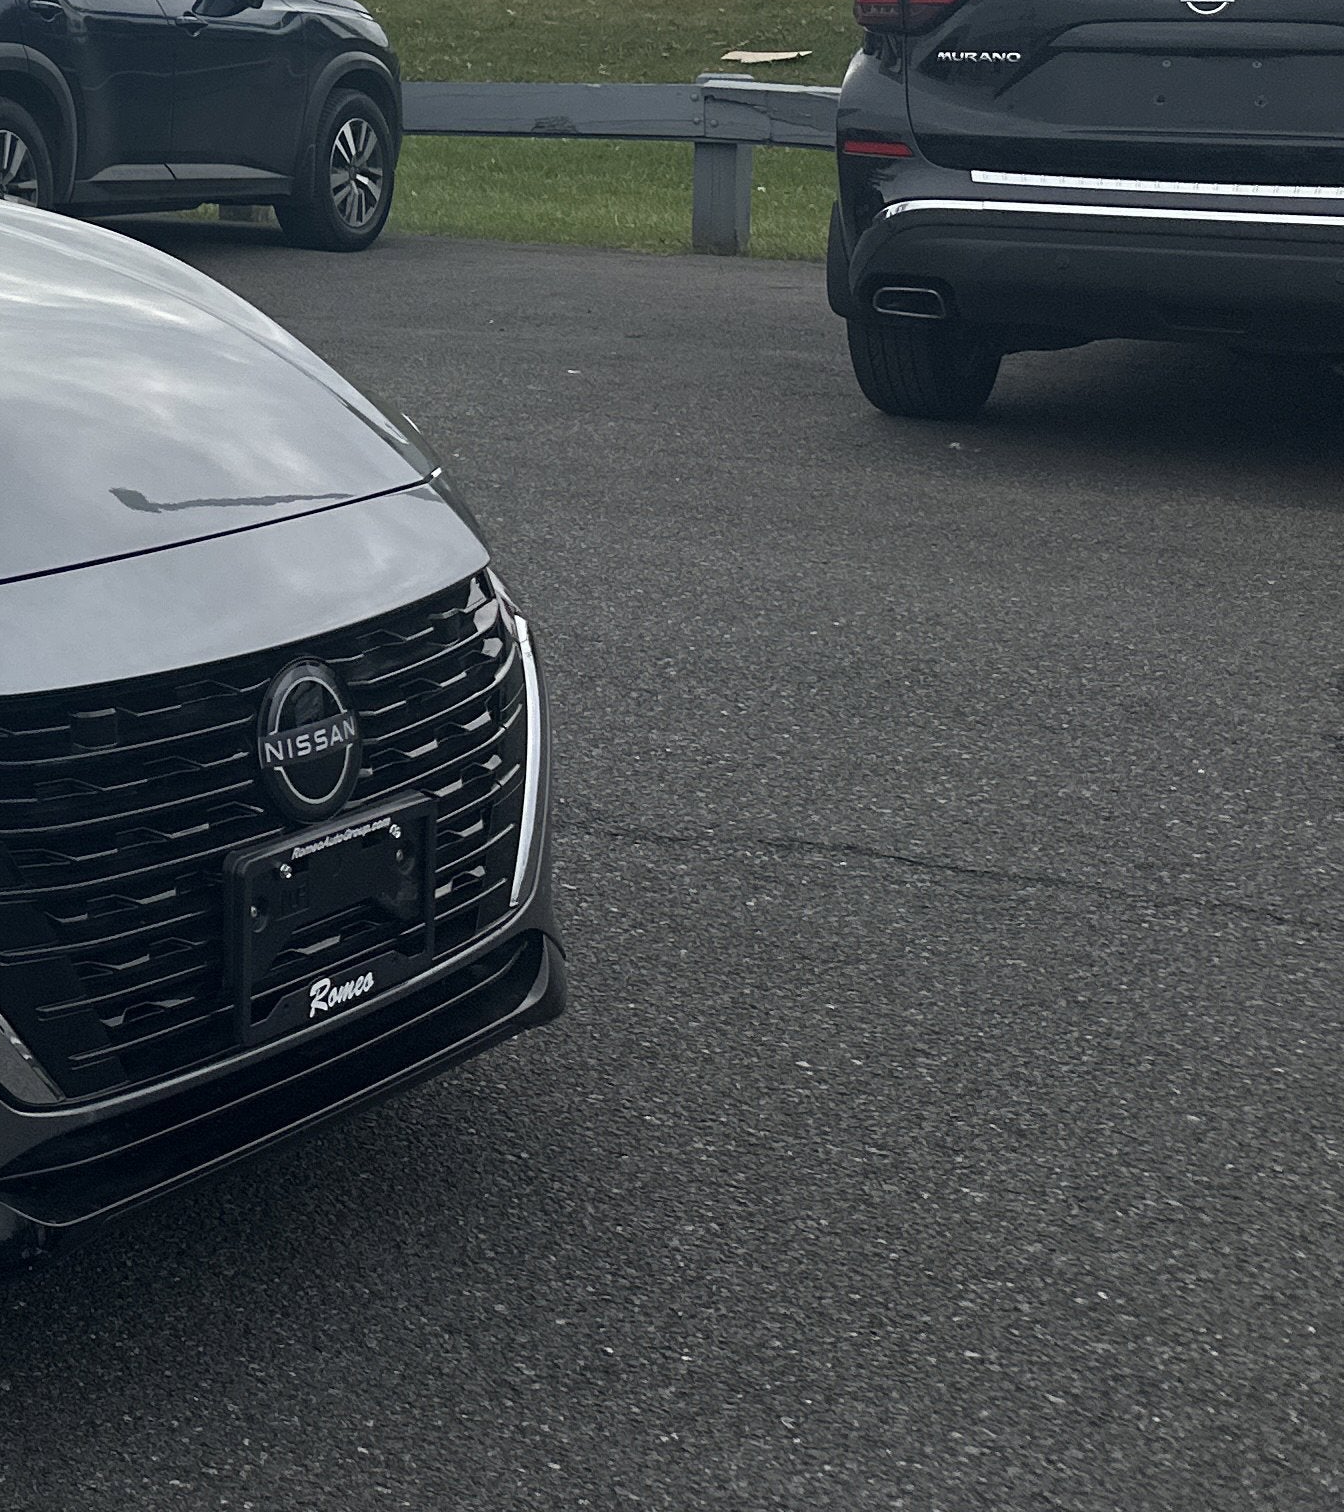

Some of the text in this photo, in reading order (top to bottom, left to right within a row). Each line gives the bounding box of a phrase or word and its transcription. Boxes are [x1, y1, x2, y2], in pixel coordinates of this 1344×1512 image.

[936, 51, 1022, 63] MURANO
[264, 715, 356, 763] NISSAN
[309, 971, 375, 1018] Romeo
